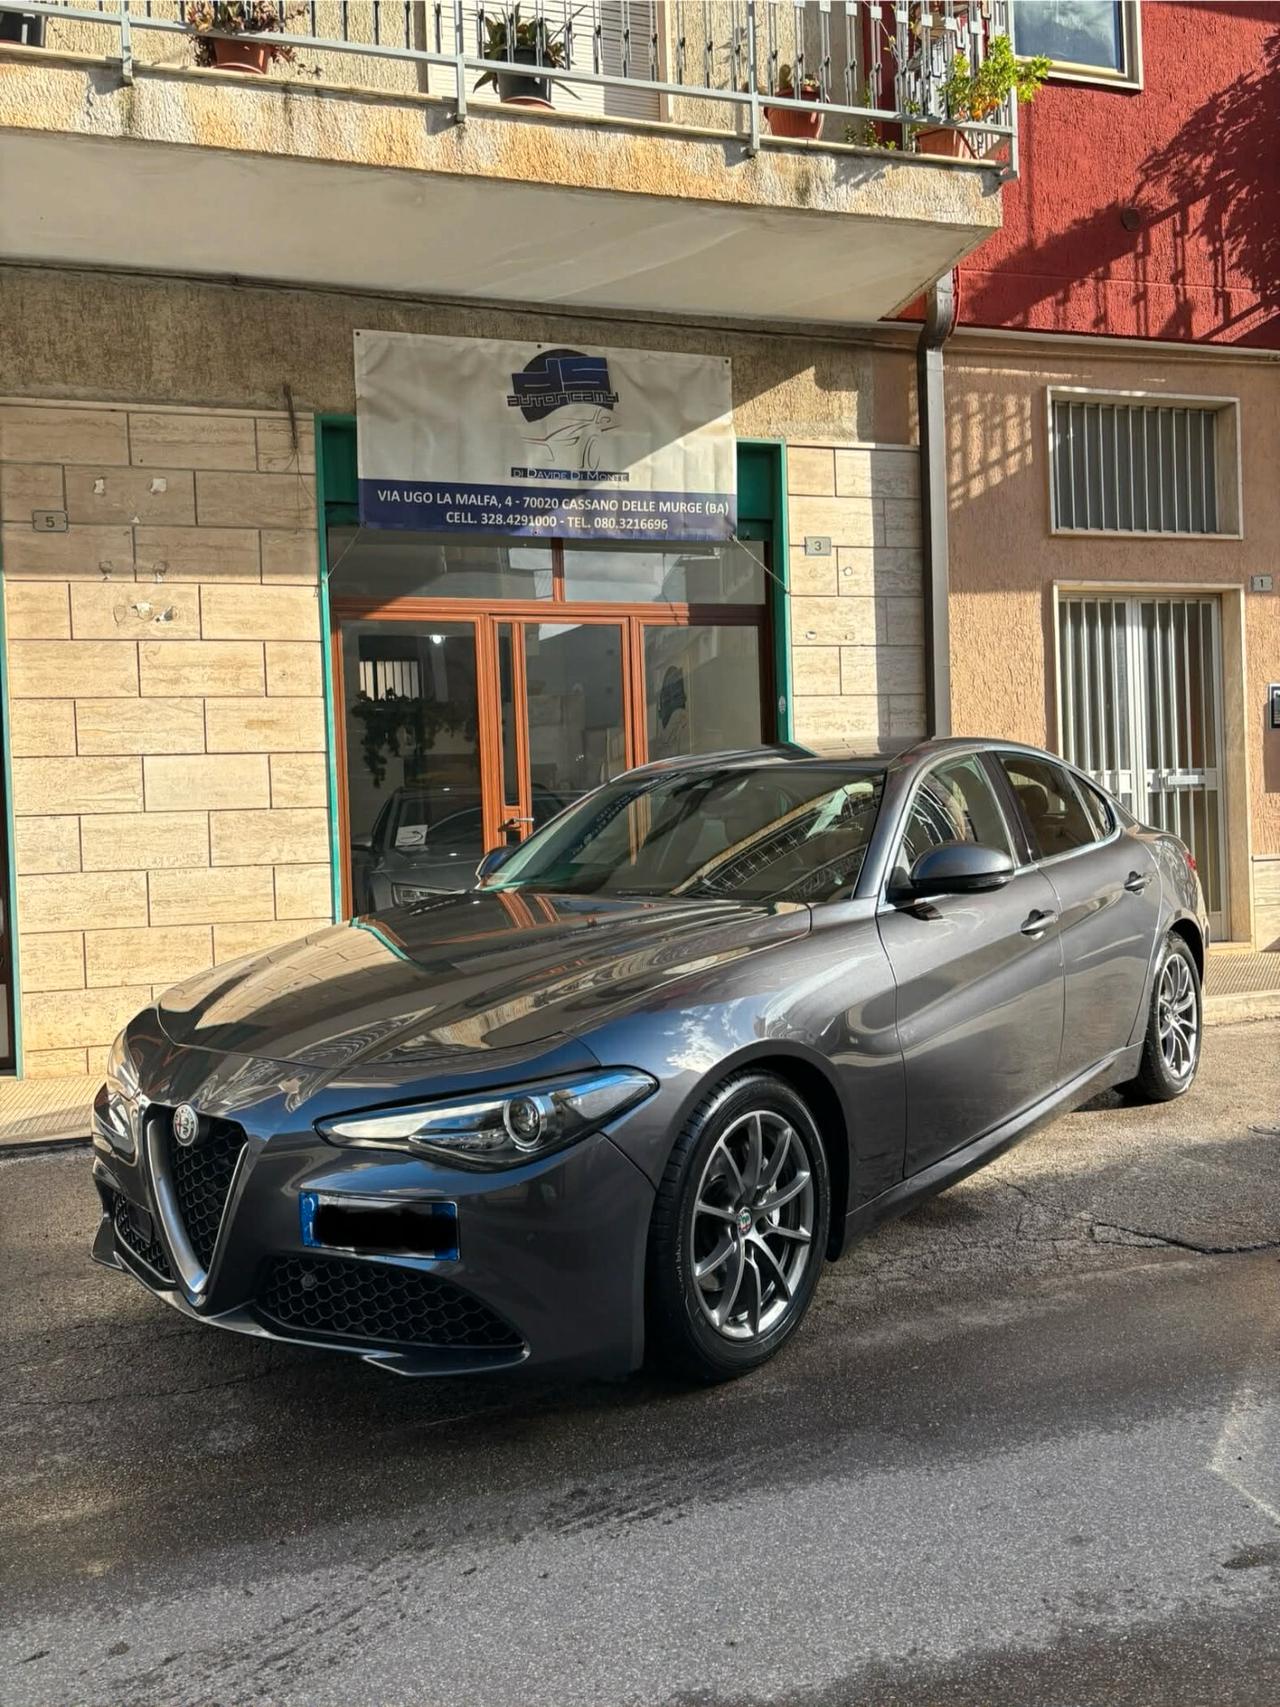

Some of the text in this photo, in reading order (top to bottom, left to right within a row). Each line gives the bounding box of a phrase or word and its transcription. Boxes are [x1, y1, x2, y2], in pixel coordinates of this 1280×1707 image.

[378, 490, 400, 502] VIA
[404, 491, 433, 504] UGO
[437, 493, 452, 504] LA
[456, 494, 501, 509] MALFA,
[504, 496, 512, 507] 4
[523, 497, 559, 509] 70020
[562, 498, 618, 511] CASSANO
[622, 500, 655, 513] DELLE
[659, 501, 702, 514] MURGE
[705, 503, 729, 516] (BA)
[46, 516, 55, 528] 5
[446, 512, 477, 524] CELL.
[481, 513, 557, 527] 328.4291000
[567, 516, 590, 529] TEL.
[594, 517, 668, 530] 080.3216696
[814, 540, 822, 551] 3
